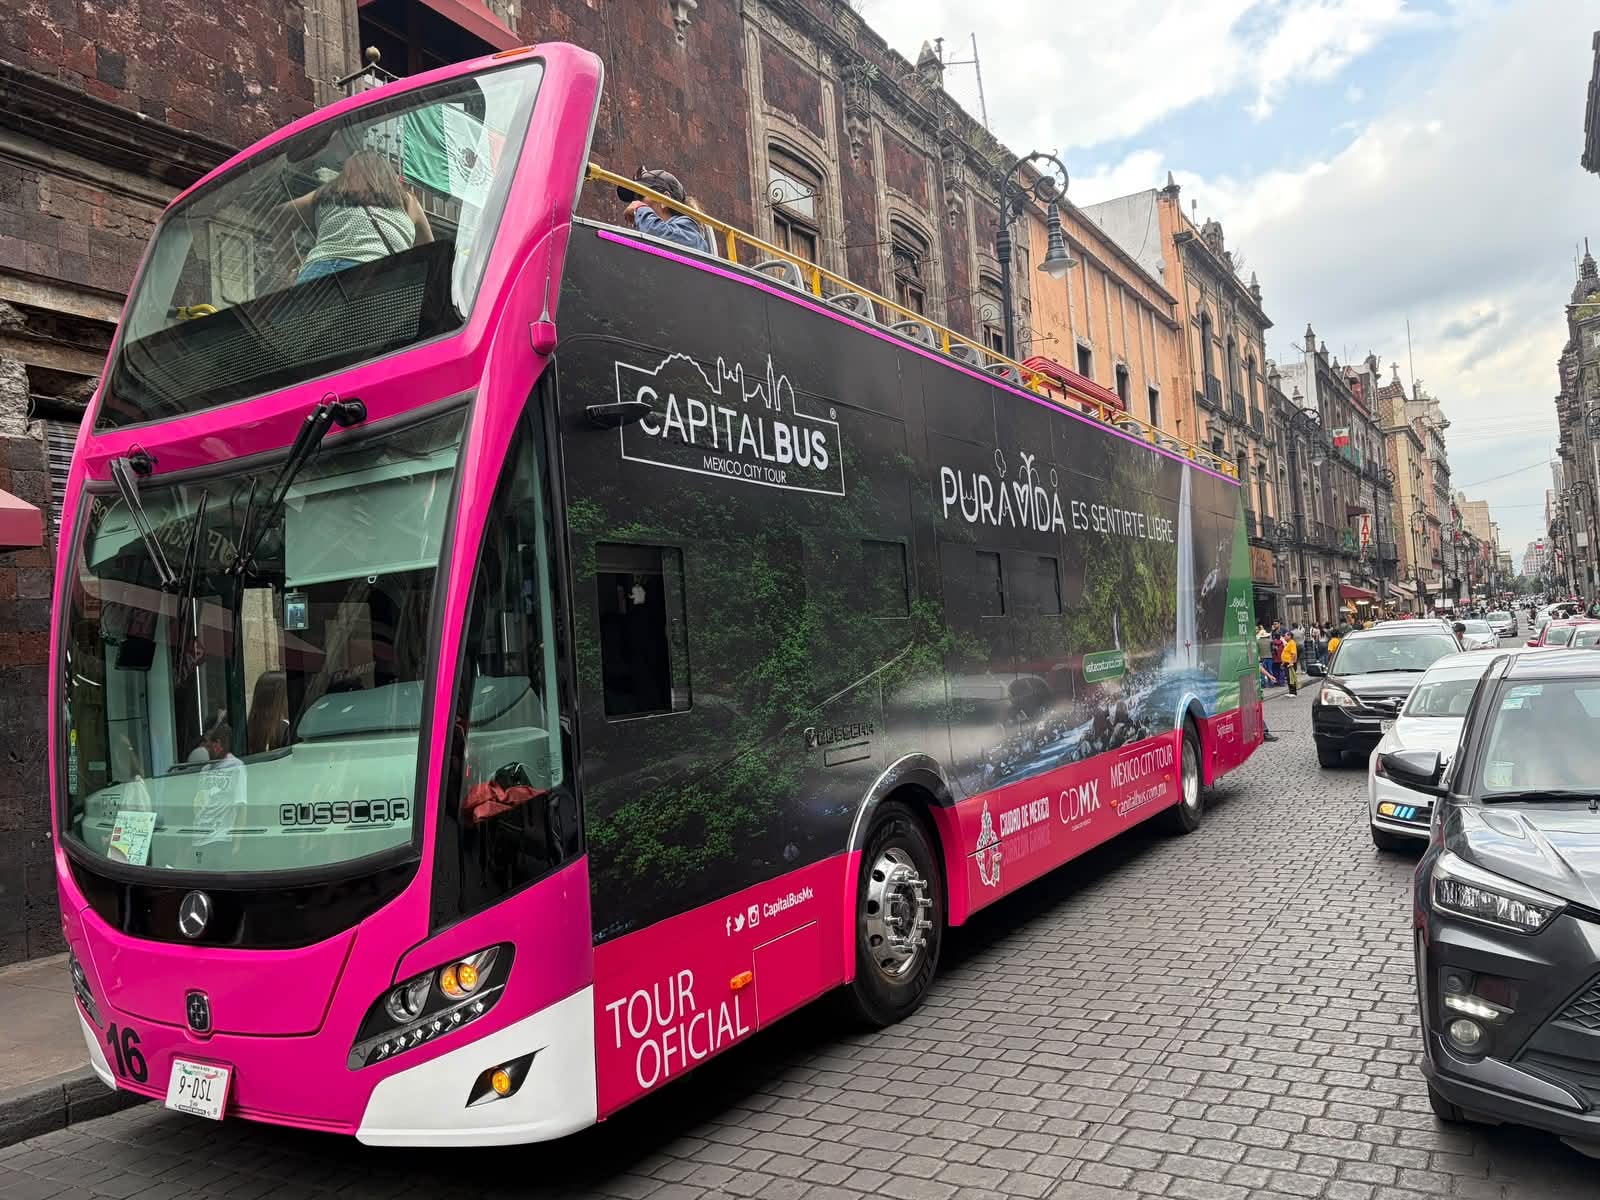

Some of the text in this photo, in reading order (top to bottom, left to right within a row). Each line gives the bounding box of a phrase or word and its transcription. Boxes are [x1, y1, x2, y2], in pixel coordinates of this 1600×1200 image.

[636, 385, 829, 471] CAPITALBUS
[703, 455, 787, 484] MEXICO CITY TOUR
[1071, 500, 1089, 531] ES
[1091, 503, 1146, 540] SENTIRTE
[1147, 516, 1175, 544] LIBRE
[1110, 744, 1174, 789] MEXICO CITY TOUR
[279, 797, 410, 826] BUSSCAR
[1021, 804, 1030, 829] DE
[1059, 778, 1101, 825] CDMX
[763, 886, 814, 918] CapitalBusMx
[605, 968, 697, 1049] TOUR
[106, 1022, 149, 1083] 16
[635, 994, 750, 1089] OFICIAL
